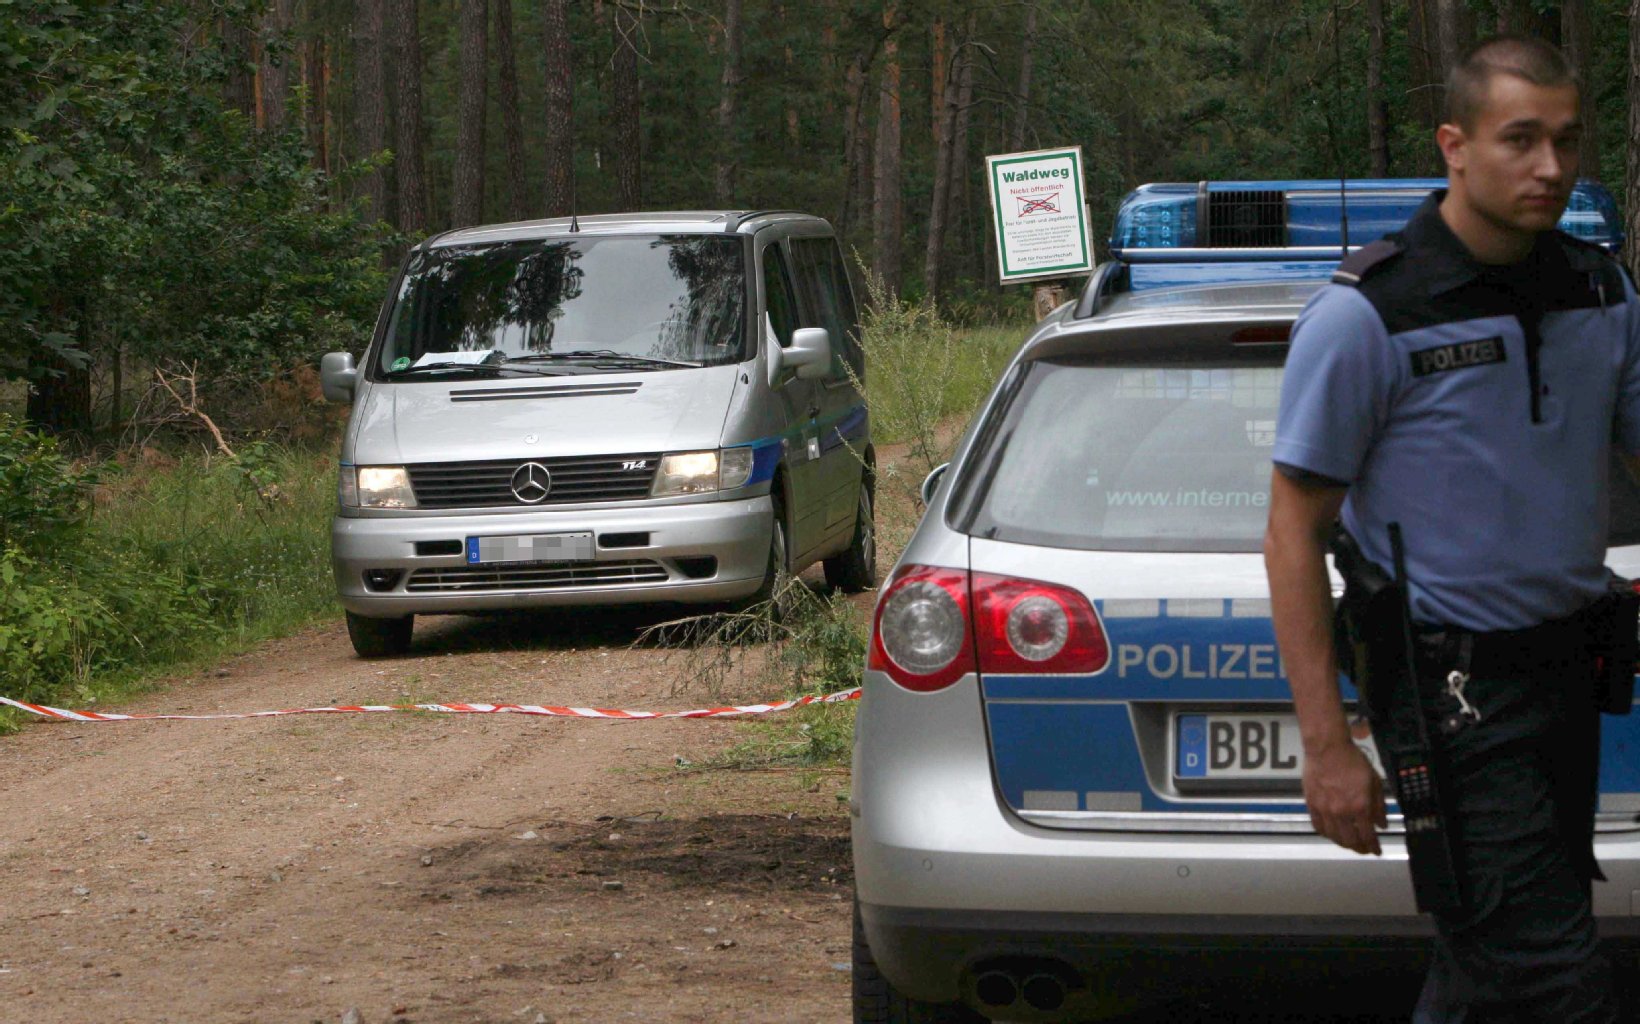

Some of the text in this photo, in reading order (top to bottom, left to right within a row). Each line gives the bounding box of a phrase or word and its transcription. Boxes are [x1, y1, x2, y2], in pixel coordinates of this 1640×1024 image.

[1002, 168, 1069, 183] Waldweg
[1010, 183, 1065, 195] Nicht öffentlich
[1420, 340, 1498, 374] POLIZEI
[1105, 486, 1271, 507] www.interne
[1186, 721, 1297, 769] D BBL
